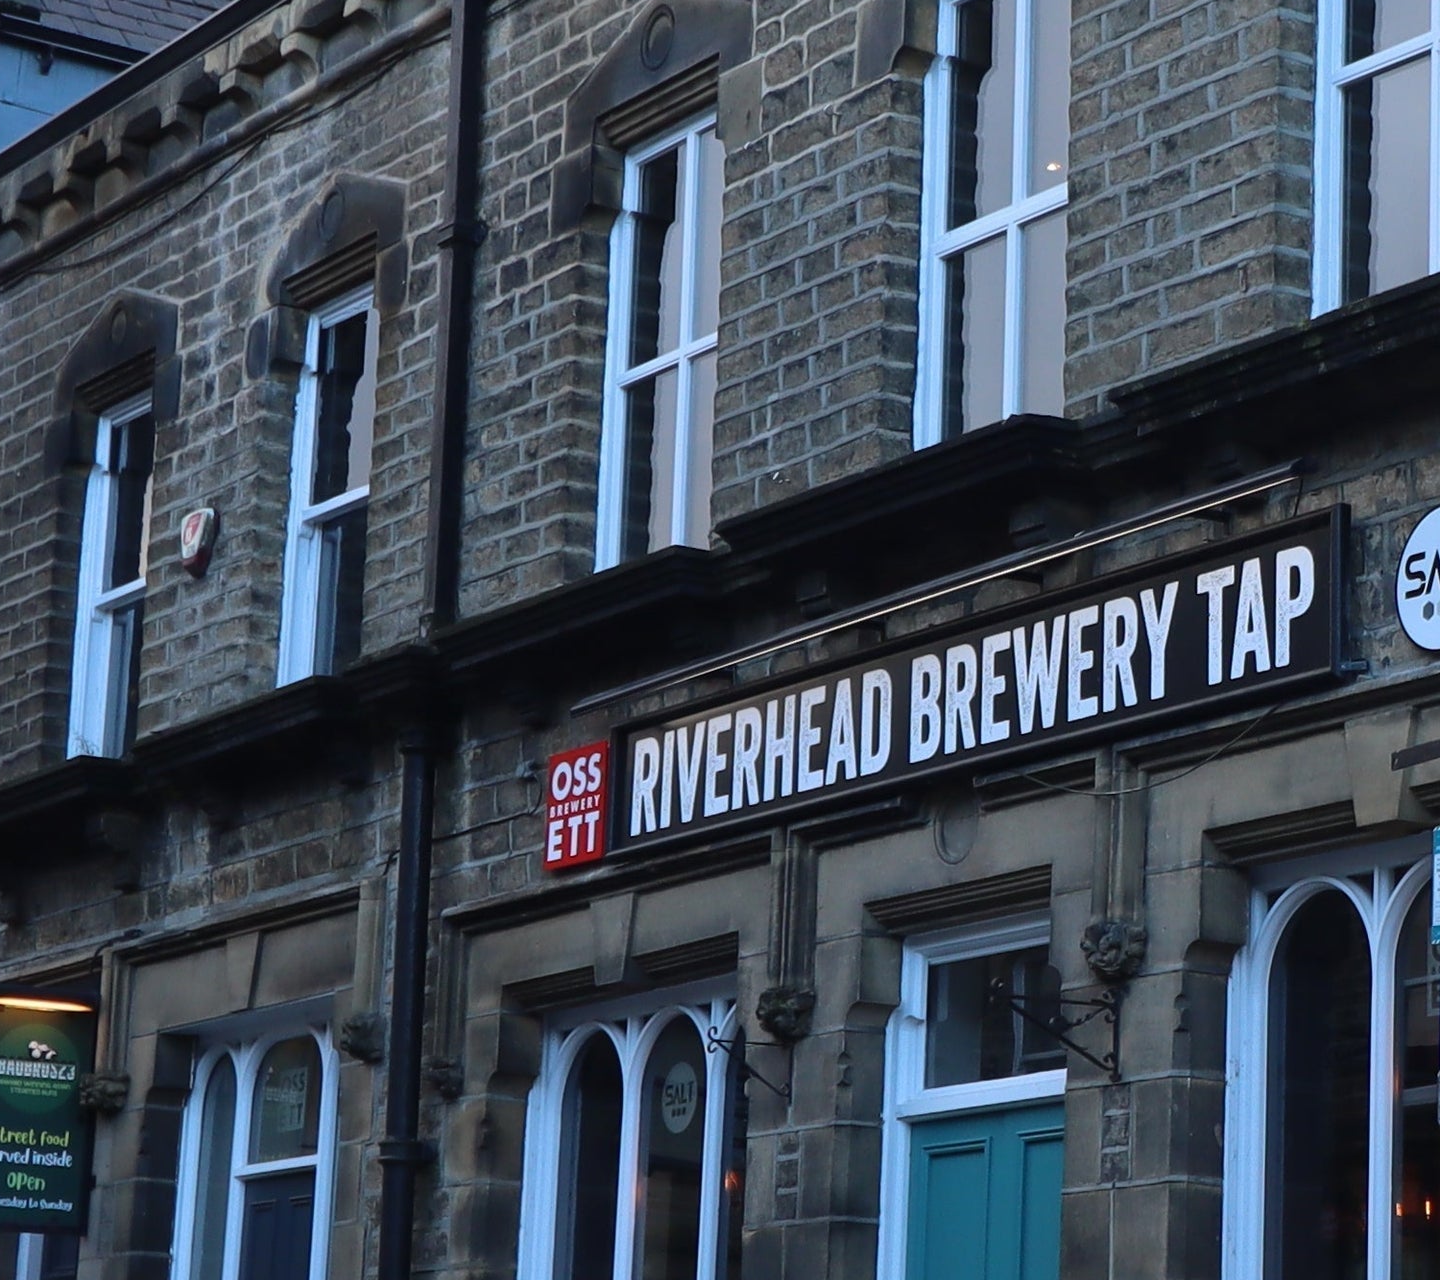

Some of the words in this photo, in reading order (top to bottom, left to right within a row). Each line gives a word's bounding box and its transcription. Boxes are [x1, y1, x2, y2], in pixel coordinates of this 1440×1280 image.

[629, 668, 892, 838] RIVERHEAD
[908, 581, 1180, 764] BREWERY
[1196, 546, 1316, 686] TAP
[552, 752, 602, 800] OSS
[549, 794, 602, 817] BREWERY
[547, 810, 601, 863] ETT
[665, 1081, 694, 1107] SALT
[40, 1131, 70, 1148] food
[32, 1150, 73, 1168] inside
